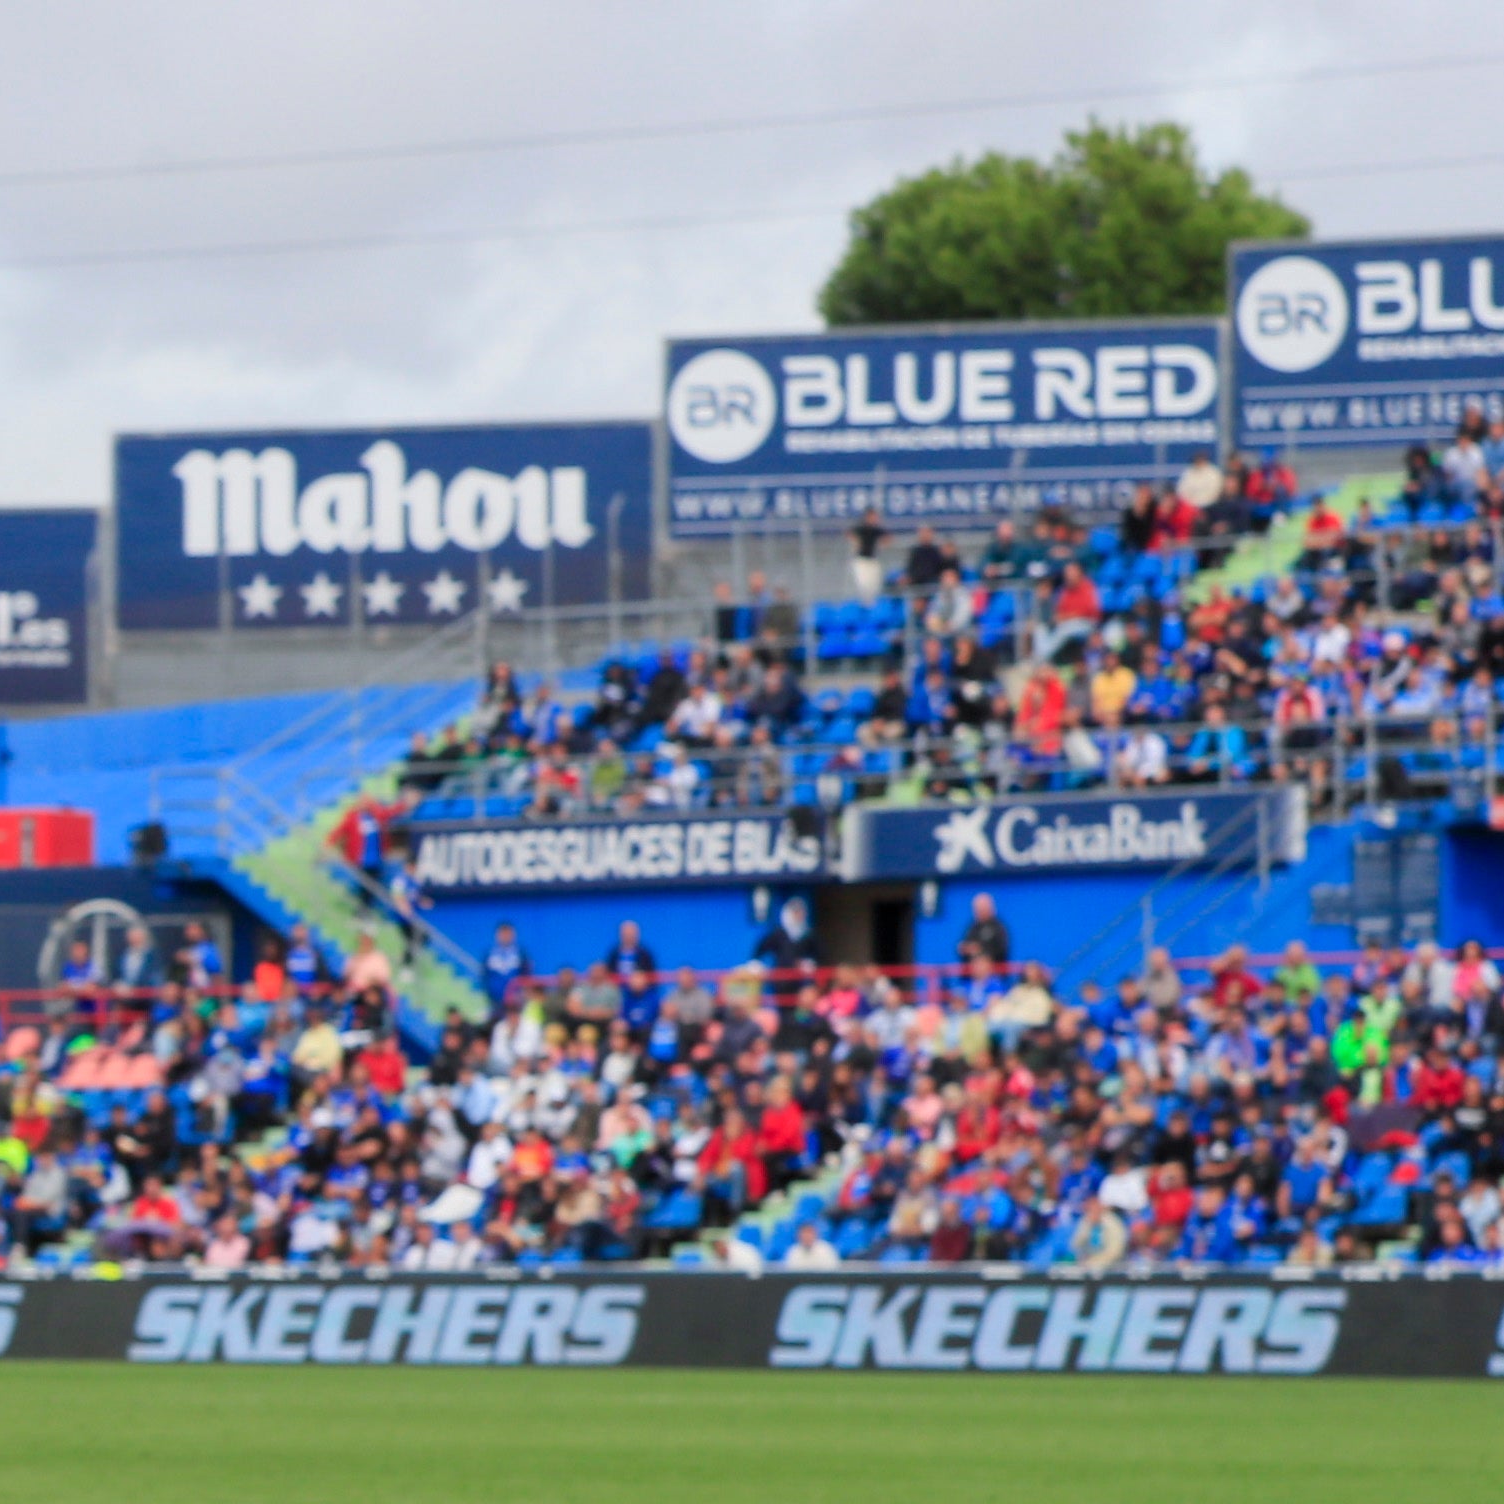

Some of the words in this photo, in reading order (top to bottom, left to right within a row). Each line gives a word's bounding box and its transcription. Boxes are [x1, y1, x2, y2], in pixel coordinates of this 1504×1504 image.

[781, 349, 1014, 428] BLUE
[1032, 344, 1218, 421] RED
[173, 440, 595, 557] Mahou
[417, 825, 684, 886] AUTODESGUACES
[687, 821, 732, 876] DE
[994, 802, 1207, 866] CaixaBank
[129, 1284, 644, 1365] SKECHERS
[770, 1285, 1344, 1375] SKECHERS
